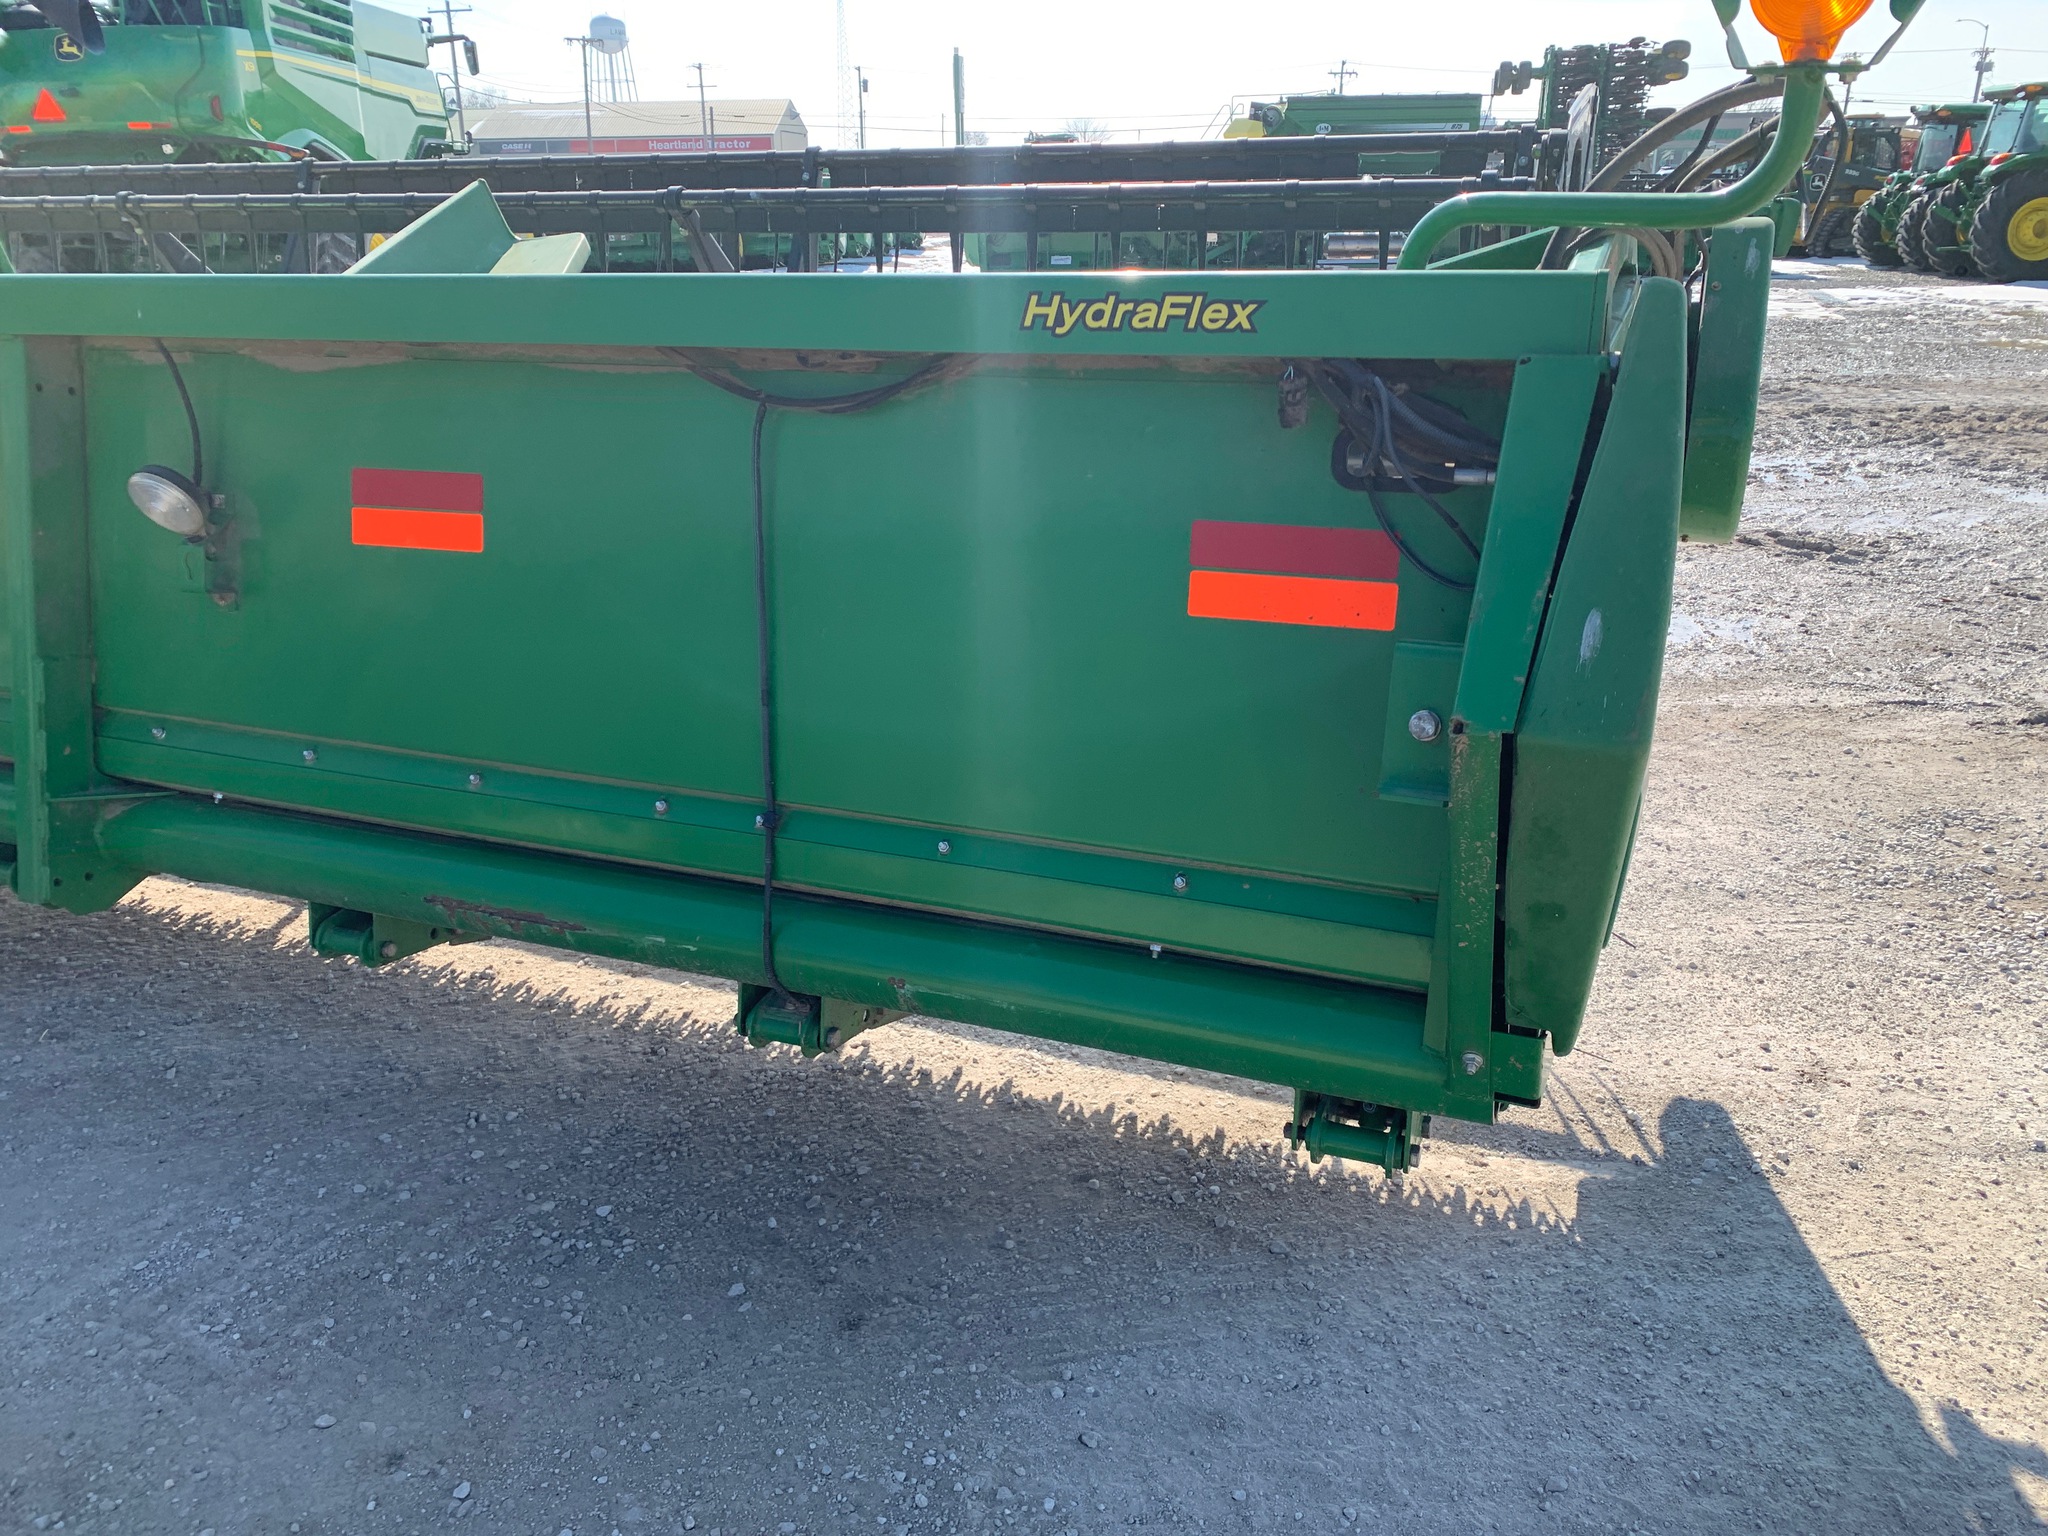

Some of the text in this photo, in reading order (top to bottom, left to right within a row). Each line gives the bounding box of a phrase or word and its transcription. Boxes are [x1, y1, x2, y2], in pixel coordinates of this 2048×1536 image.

[649, 139, 751, 150] Heartland Tractor
[1021, 292, 1264, 337] HydraFlex
